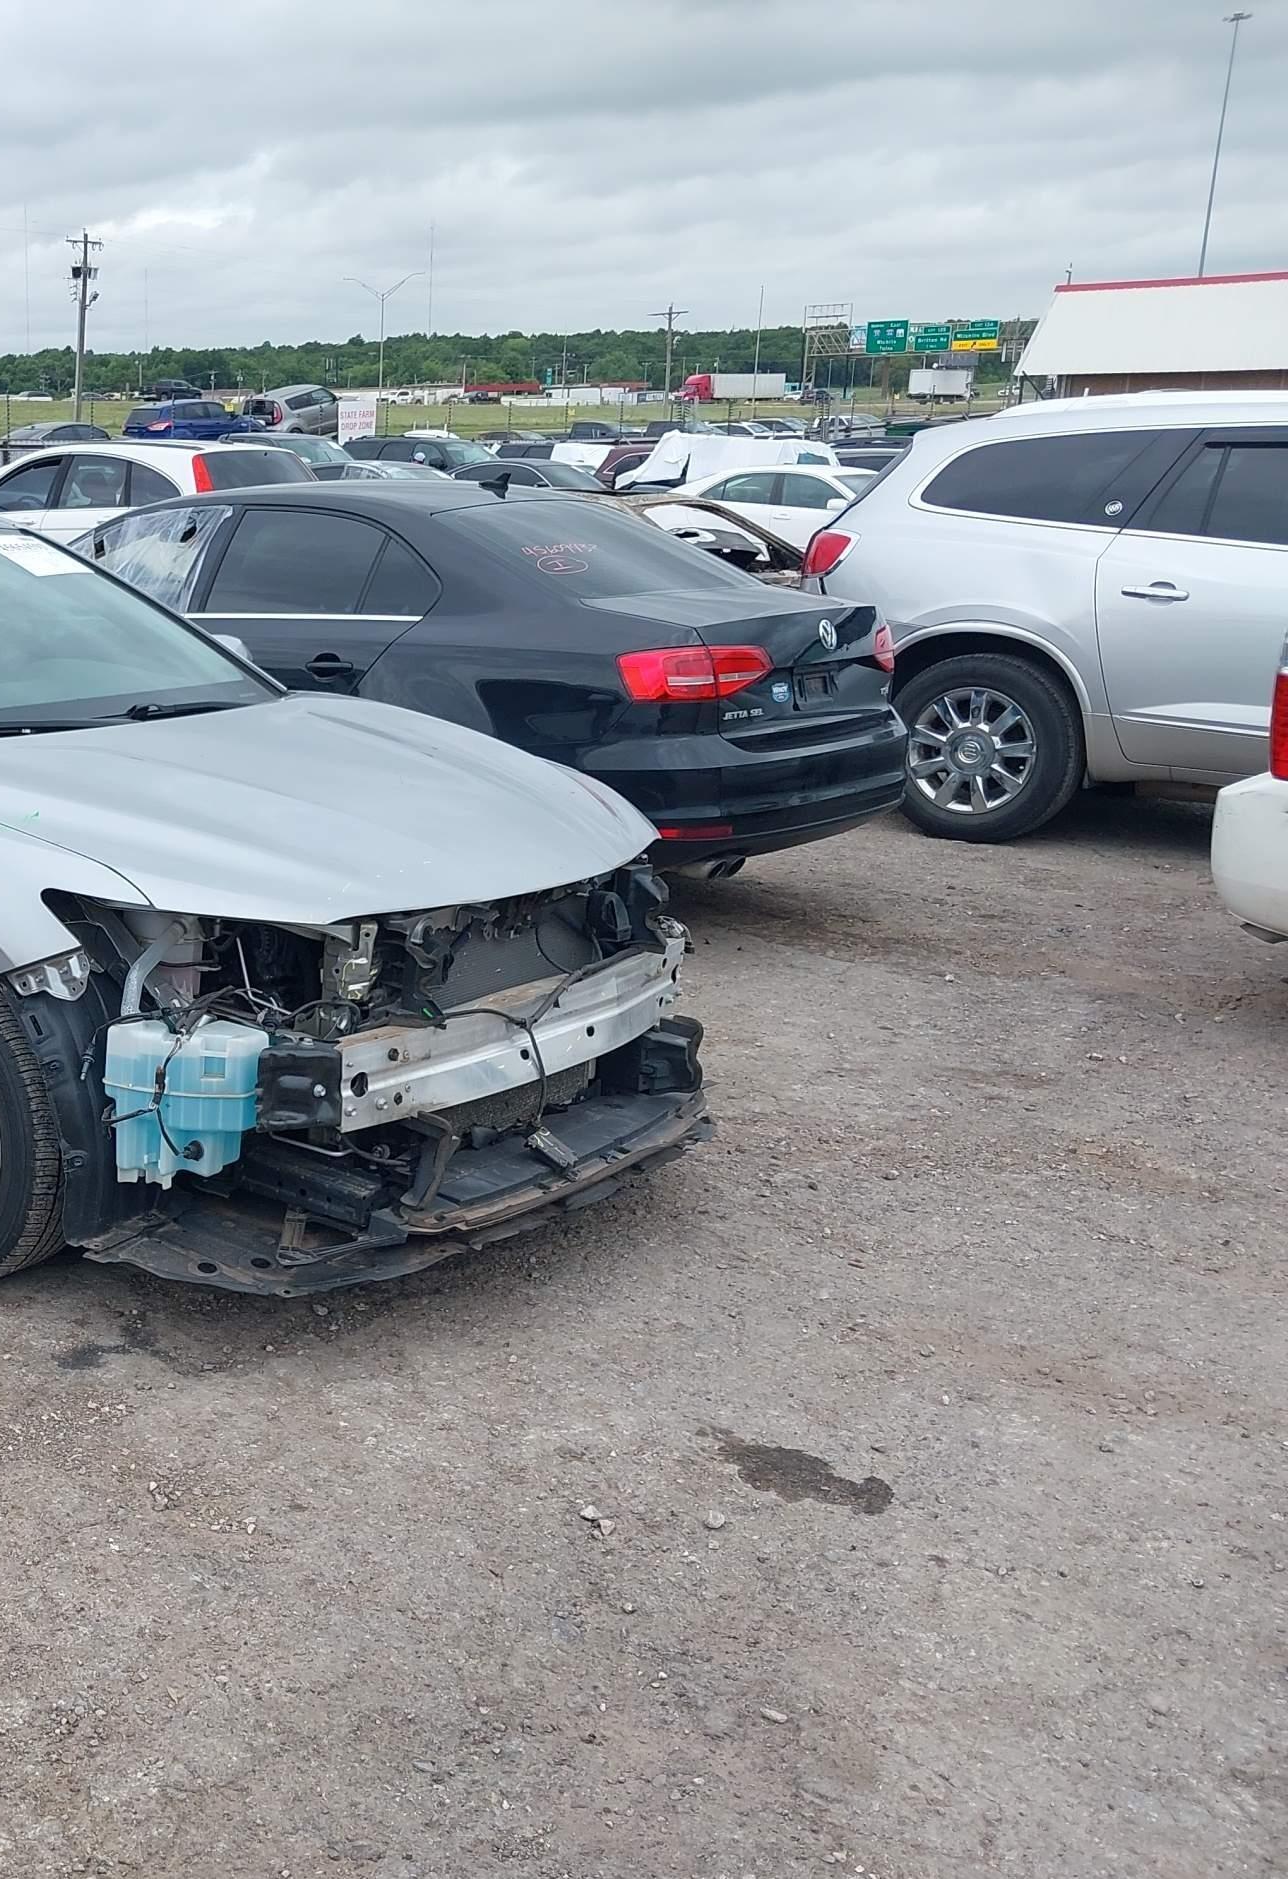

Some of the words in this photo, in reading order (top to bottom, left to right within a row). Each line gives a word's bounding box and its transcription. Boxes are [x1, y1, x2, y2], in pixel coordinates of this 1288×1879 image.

[340, 411, 357, 419] STATE
[359, 410, 374, 418] FARM
[341, 422, 357, 430] DROP
[358, 421, 373, 430] ZONE
[722, 710, 748, 720] JETTA
[750, 708, 764, 717] SEL
